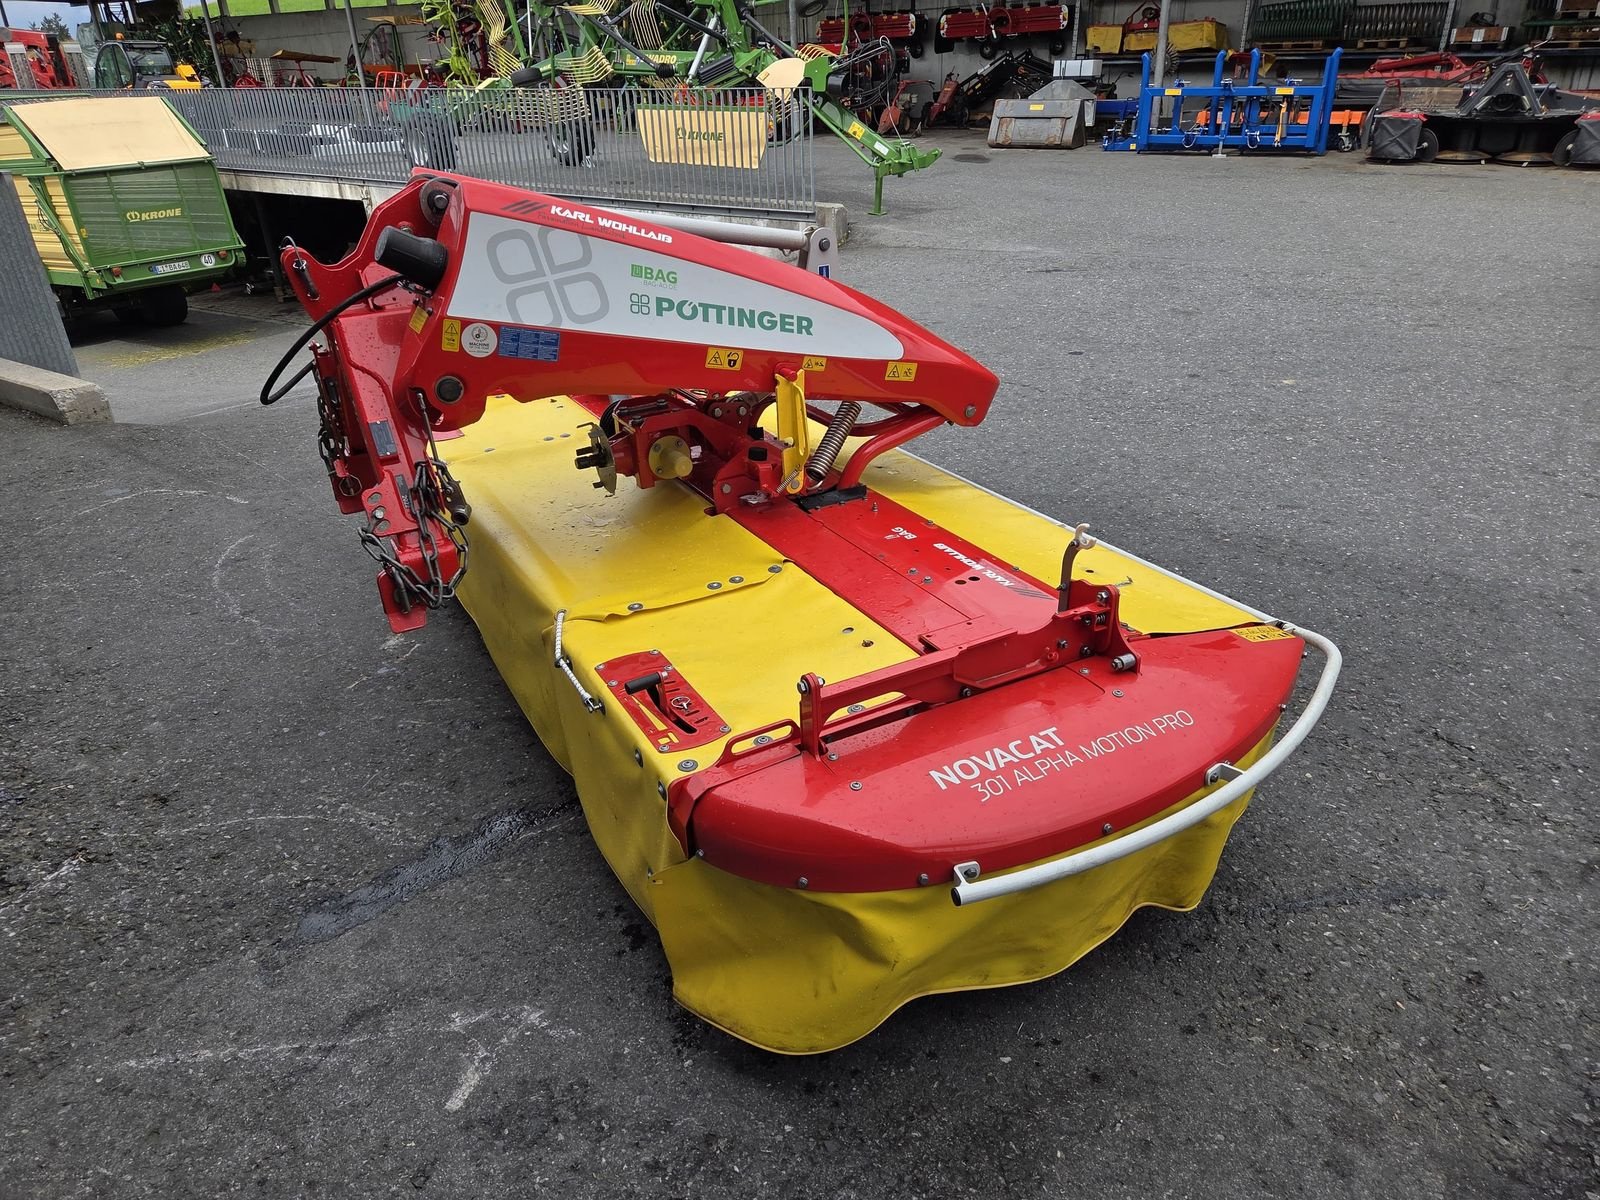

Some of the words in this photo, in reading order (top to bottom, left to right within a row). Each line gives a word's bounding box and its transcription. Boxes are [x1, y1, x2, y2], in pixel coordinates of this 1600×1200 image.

[141, 208, 182, 221] KRONE
[551, 205, 594, 224] KARL
[598, 216, 673, 244] WOHLLAIB
[203, 255, 213, 264] 40
[644, 266, 678, 284] BAG
[655, 296, 813, 336] PÖTTINGER
[891, 526, 918, 540] BAG
[982, 570, 1015, 586] KARL
[929, 726, 1066, 790] NOVACAT
[970, 774, 1012, 802] 301
[1013, 749, 1084, 787] ALPHA
[1079, 723, 1157, 760] MOTION
[1152, 710, 1195, 734] PRO
